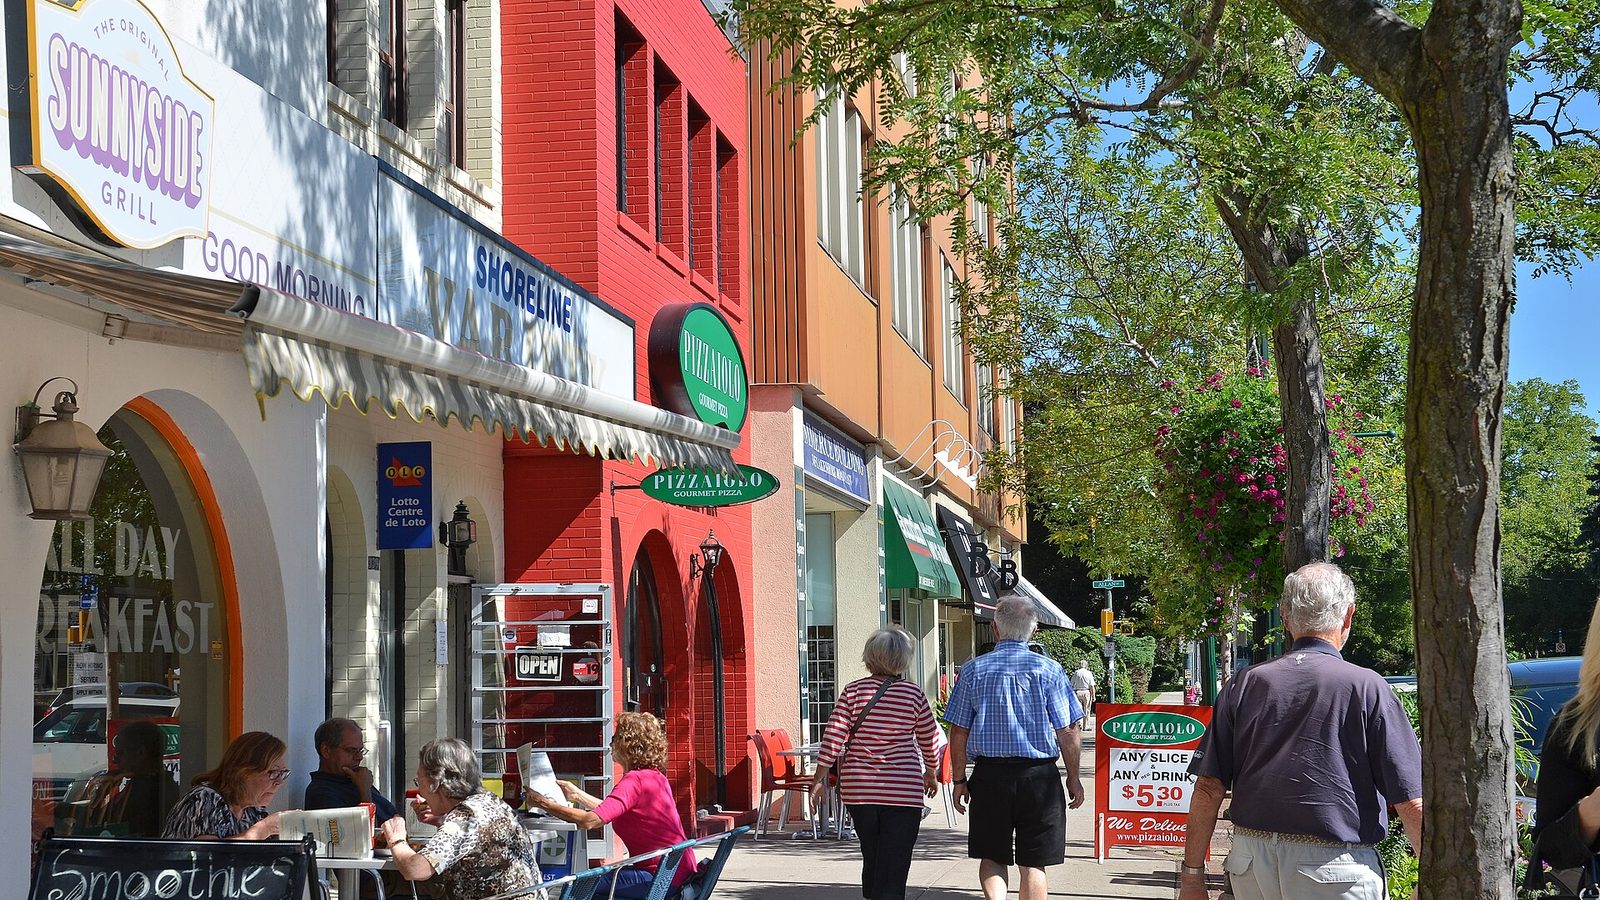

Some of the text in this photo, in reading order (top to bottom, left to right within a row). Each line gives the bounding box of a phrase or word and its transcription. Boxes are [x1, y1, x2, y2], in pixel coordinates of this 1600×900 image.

[93, 18, 169, 82] THE ORIGINAL
[49, 33, 203, 210] SUNNYSIDE
[102, 181, 157, 226] GRILL
[202, 230, 364, 317] GOOD MORNING
[475, 245, 572, 334] SHORELINE
[683, 329, 741, 403] PIZZAIOLO
[698, 392, 728, 418] GOURMET PIZZA
[386, 465, 424, 478] OLG
[391, 497, 420, 507] Lotto
[673, 490, 716, 498] GOURMET
[385, 518, 426, 527] de Loto
[388, 507, 423, 516] Centre
[115, 521, 181, 580] DAY
[998, 559, 1019, 590] B
[35, 593, 214, 655] REAKFAST
[519, 655, 558, 675] OPEN
[1112, 721, 1196, 735] PIZZAIOLO
[1119, 752, 1188, 764] ANY SLICE
[1113, 769, 1140, 780] ANY
[1151, 771, 1191, 782] DRINK
[1121, 784, 1183, 807] $5.30
[1106, 816, 1187, 832] We Delive
